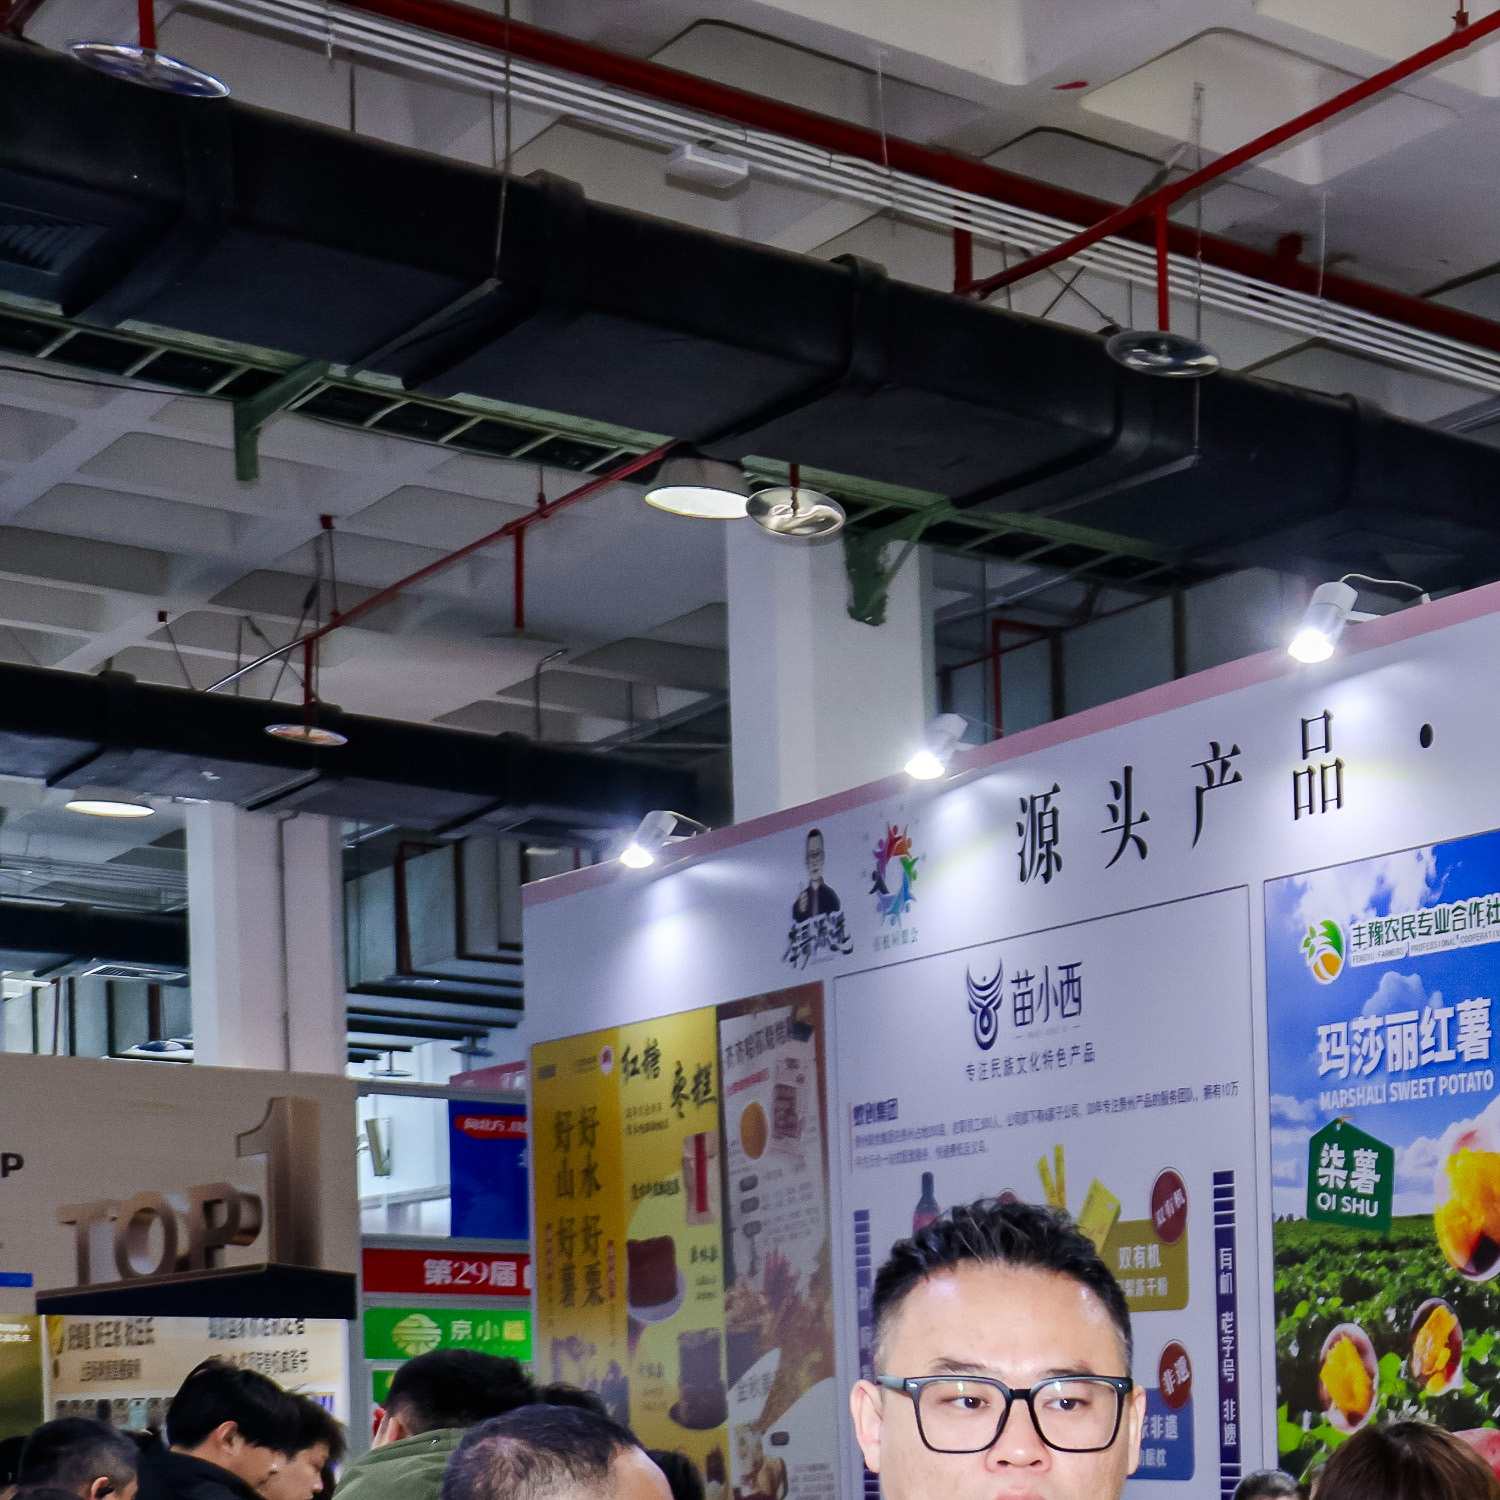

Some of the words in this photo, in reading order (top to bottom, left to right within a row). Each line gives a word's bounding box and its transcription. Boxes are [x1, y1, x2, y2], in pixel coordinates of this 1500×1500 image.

[1011, 961, 1083, 1028] 苗小西
[965, 1042, 1096, 1081] 专注民族文化特色产品
[1316, 996, 1492, 1080] 玛莎丽红薯
[1390, 1077, 1435, 1102] SWEET
[1438, 1069, 1495, 1096] POTATO
[1317, 1141, 1382, 1196] 柒薯
[1316, 1192, 1337, 1213] QI
[1340, 1195, 1379, 1218] SHU
[57, 1181, 263, 1287] TOP
[423, 1257, 518, 1287] 第29届
[1221, 1311, 1236, 1382] 老字号
[1162, 1355, 1191, 1396] 非遗
